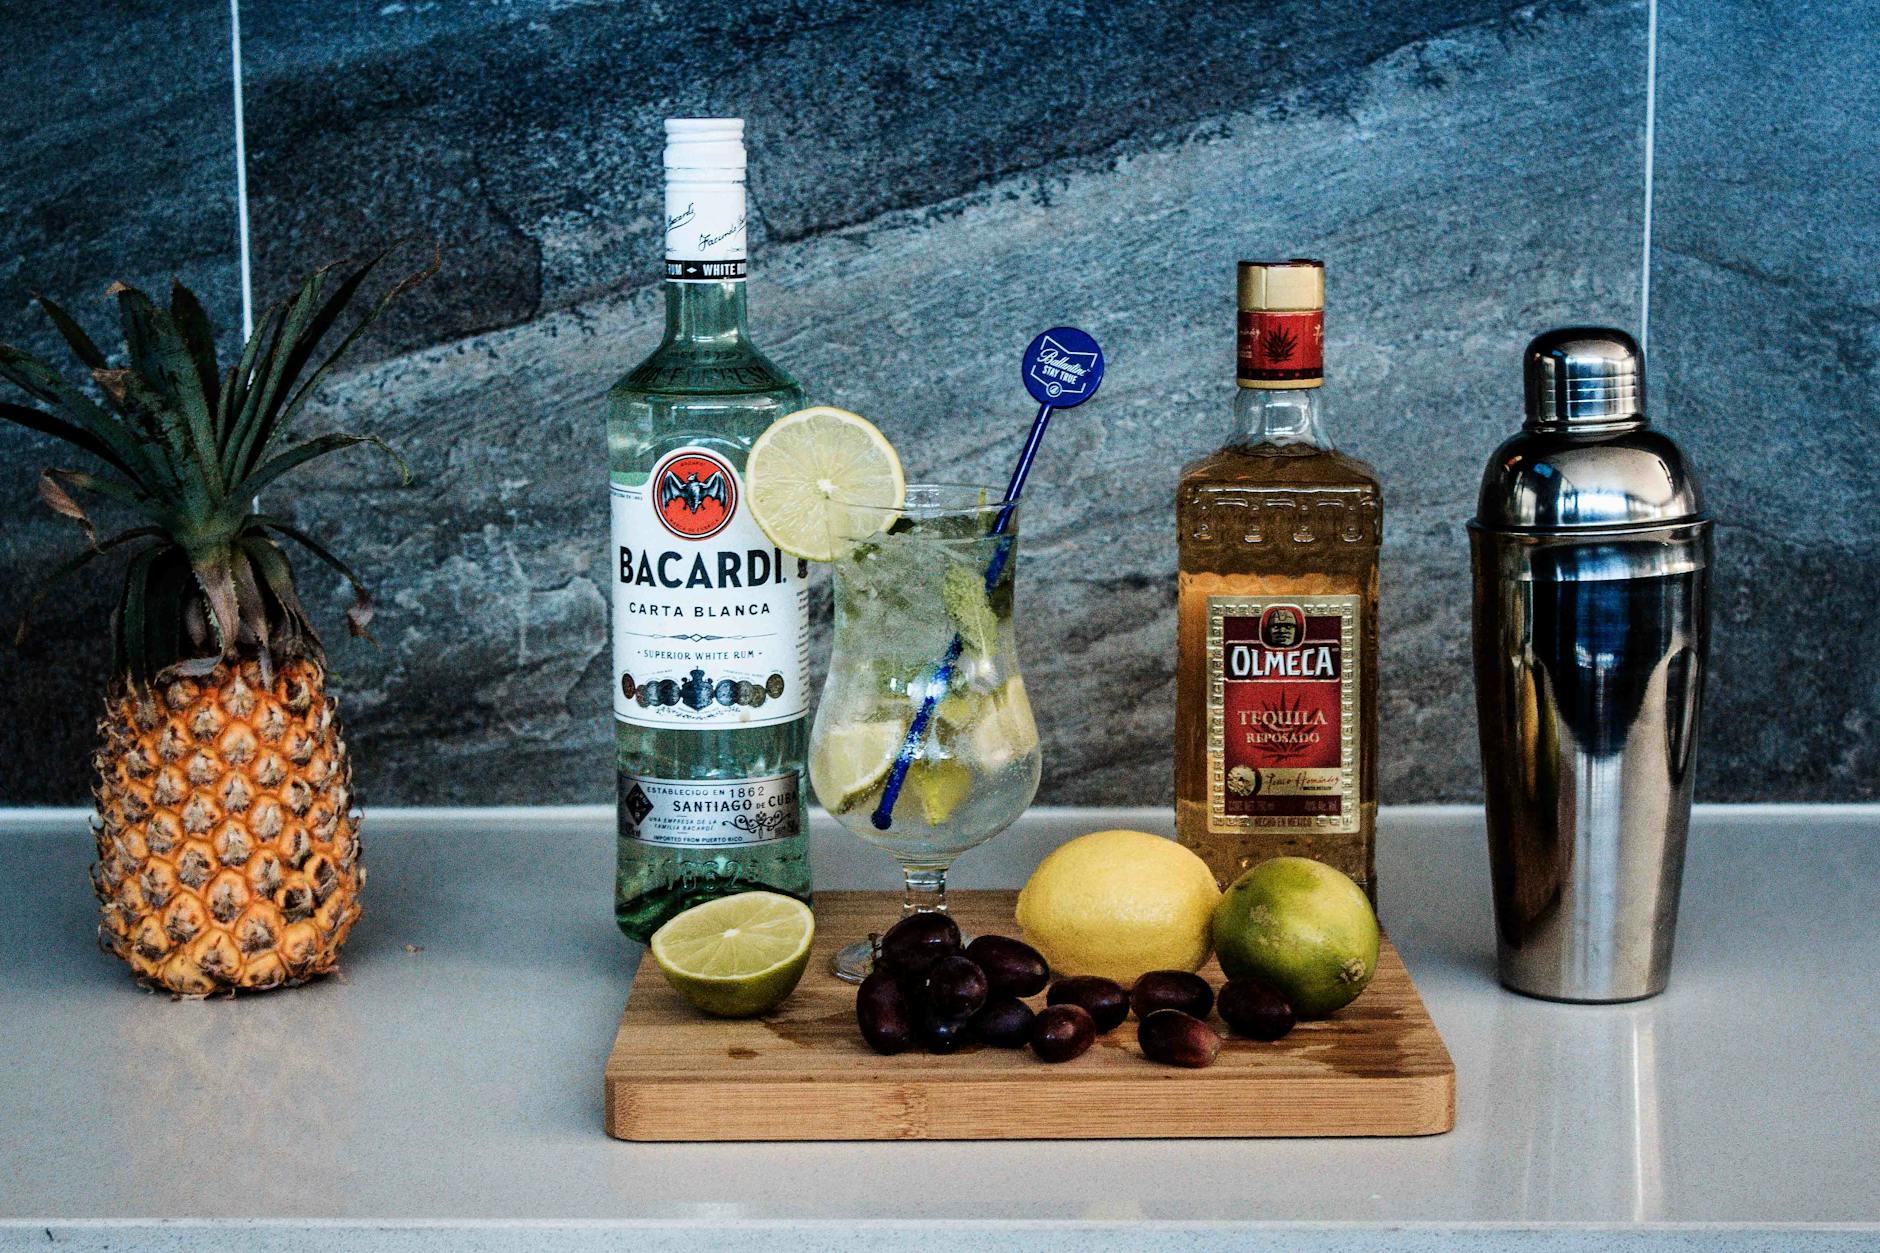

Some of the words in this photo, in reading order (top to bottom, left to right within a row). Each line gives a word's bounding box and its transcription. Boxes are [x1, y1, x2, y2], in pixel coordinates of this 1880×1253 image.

[702, 263, 736, 276] WHITE
[1041, 364, 1061, 378] STAY
[1059, 370, 1079, 385] TRUE
[619, 546, 782, 588] BACARDI
[629, 602, 684, 617] CARTA
[694, 603, 771, 618] BLANCA
[644, 650, 691, 660] SUPERIOR
[695, 652, 729, 660] WHITE
[733, 650, 755, 659] RUM
[1231, 646, 1335, 677] OLMECA
[1237, 710, 1328, 732] TEQUILA
[1246, 733, 1321, 743] REPOSADO
[647, 786, 709, 796] ESTABLECIDO
[730, 786, 765, 798] 1862
[673, 800, 752, 812] SANTIAGO
